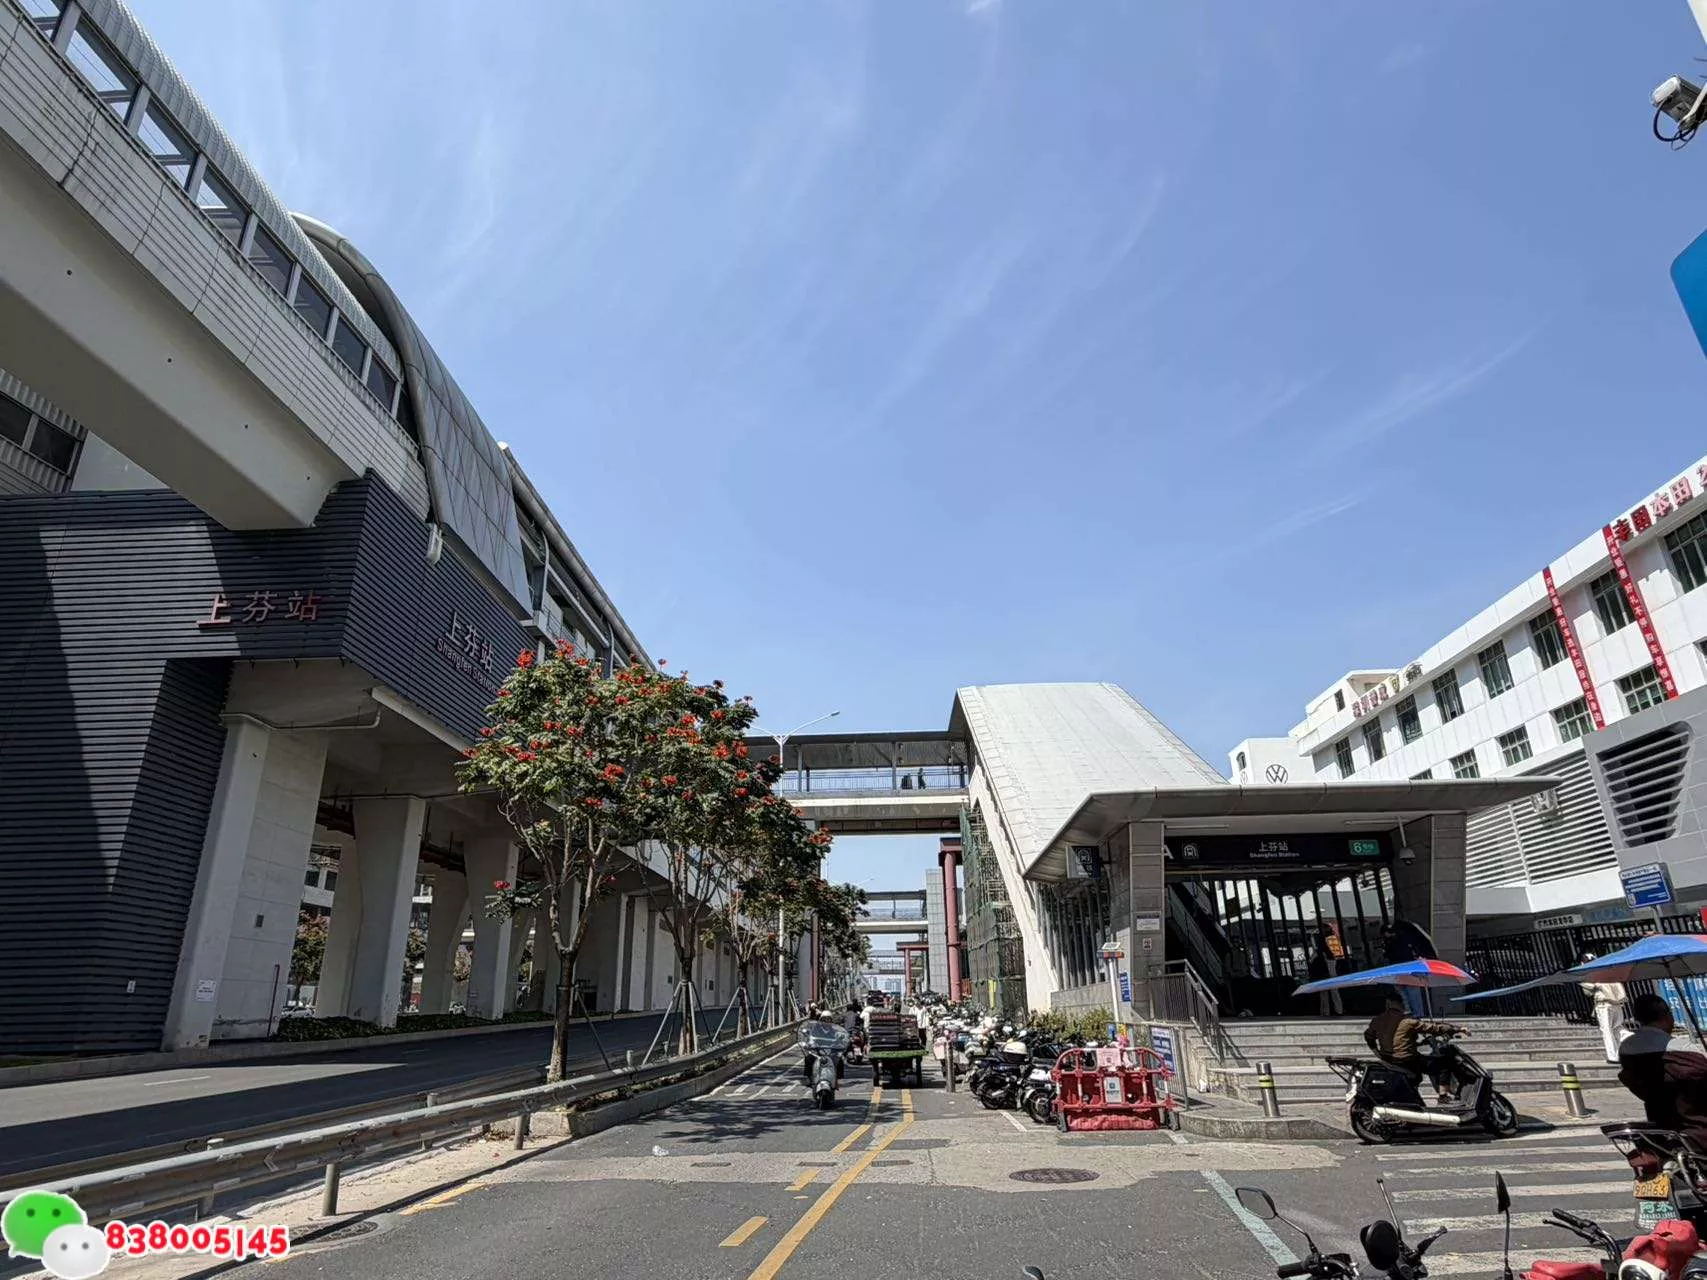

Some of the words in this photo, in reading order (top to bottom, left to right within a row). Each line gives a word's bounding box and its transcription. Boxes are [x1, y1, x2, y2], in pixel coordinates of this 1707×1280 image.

[196, 589, 322, 627] 上芬站
[436, 637, 473, 676] Shangfen
[445, 611, 494, 673] 上芬站
[1258, 840, 1289, 852] 上芬站
